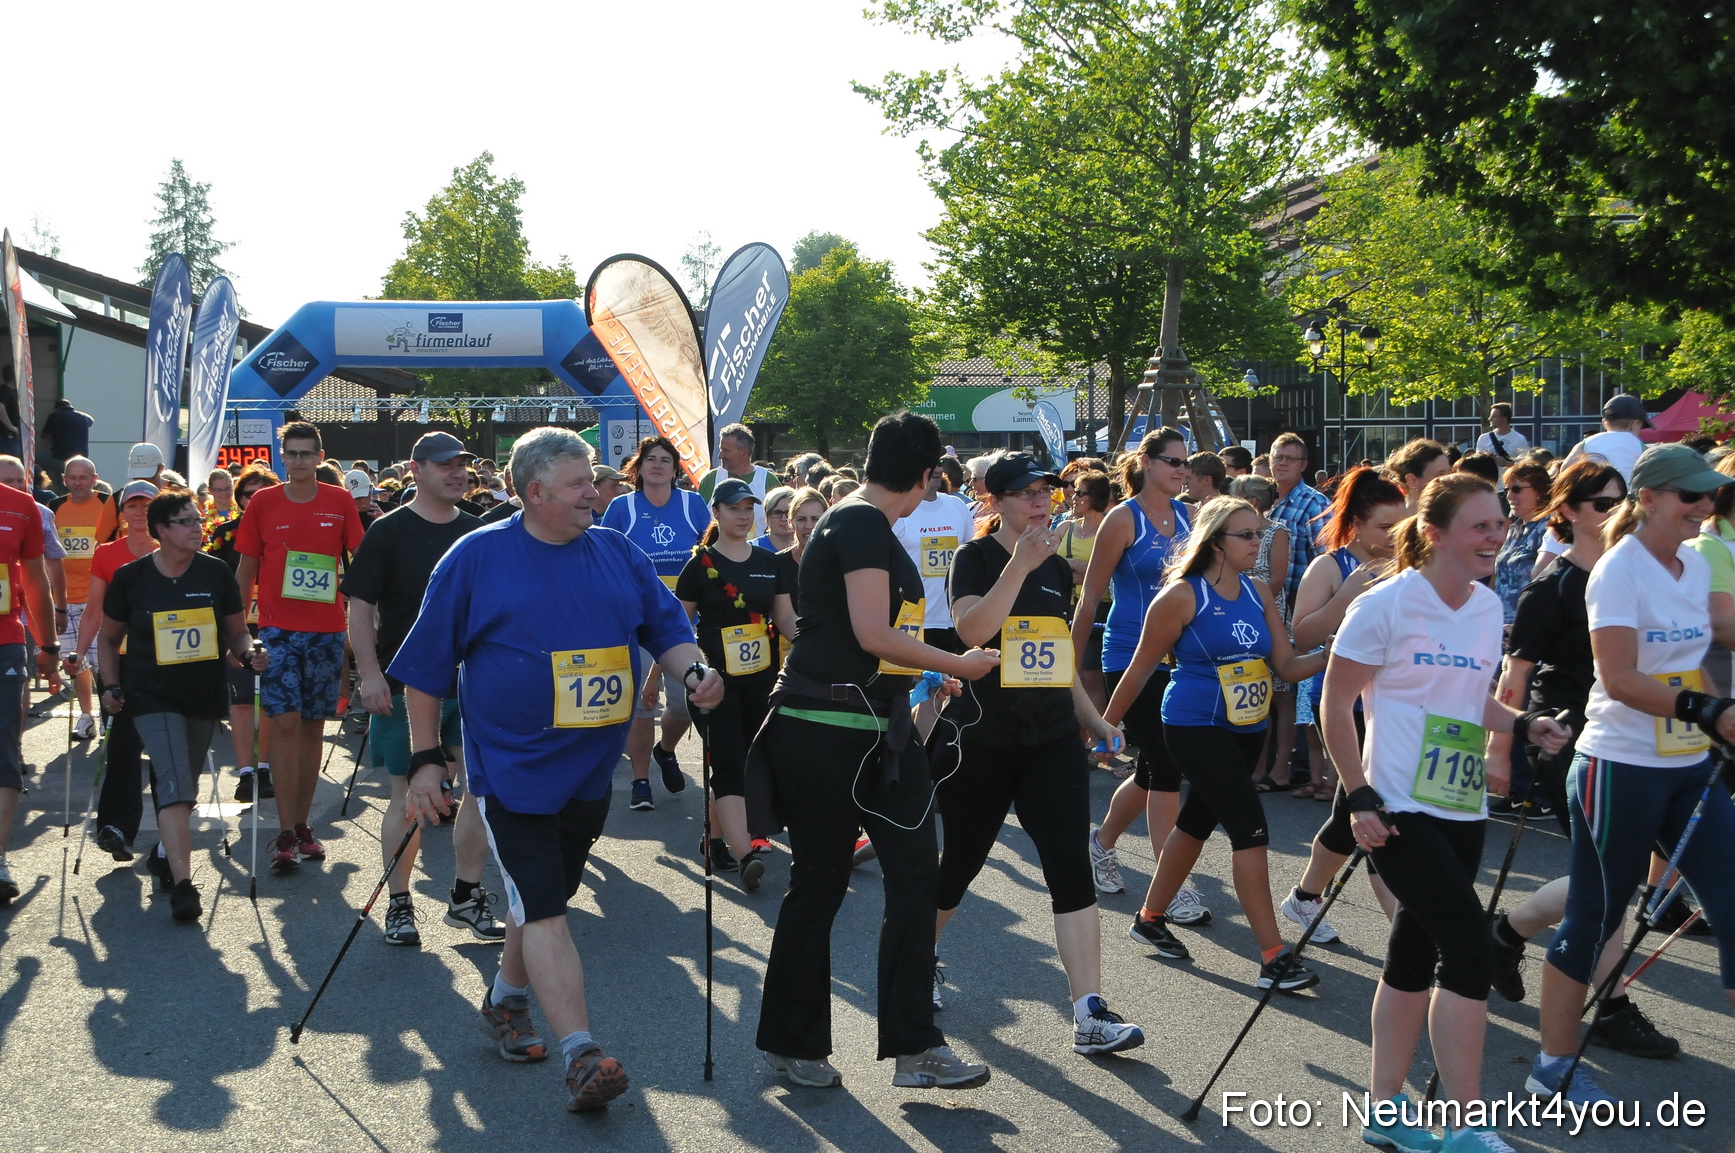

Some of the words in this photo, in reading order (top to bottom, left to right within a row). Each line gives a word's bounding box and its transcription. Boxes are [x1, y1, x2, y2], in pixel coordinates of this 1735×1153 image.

[162, 282, 184, 401] Fischer
[416, 333, 493, 348] firmenlauf
[720, 270, 771, 394] Fischer
[735, 292, 777, 392] AUTOMOBILE
[205, 301, 229, 405] Fischer
[267, 358, 309, 368] Fischer
[63, 538, 90, 551] 928
[928, 549, 955, 567] 519
[291, 567, 330, 591] 934
[171, 627, 201, 650] 70
[739, 640, 761, 662] 82
[1020, 641, 1056, 669] 85
[568, 674, 623, 708] 129
[1233, 680, 1268, 711] 289
[1424, 747, 1484, 791] 1193
